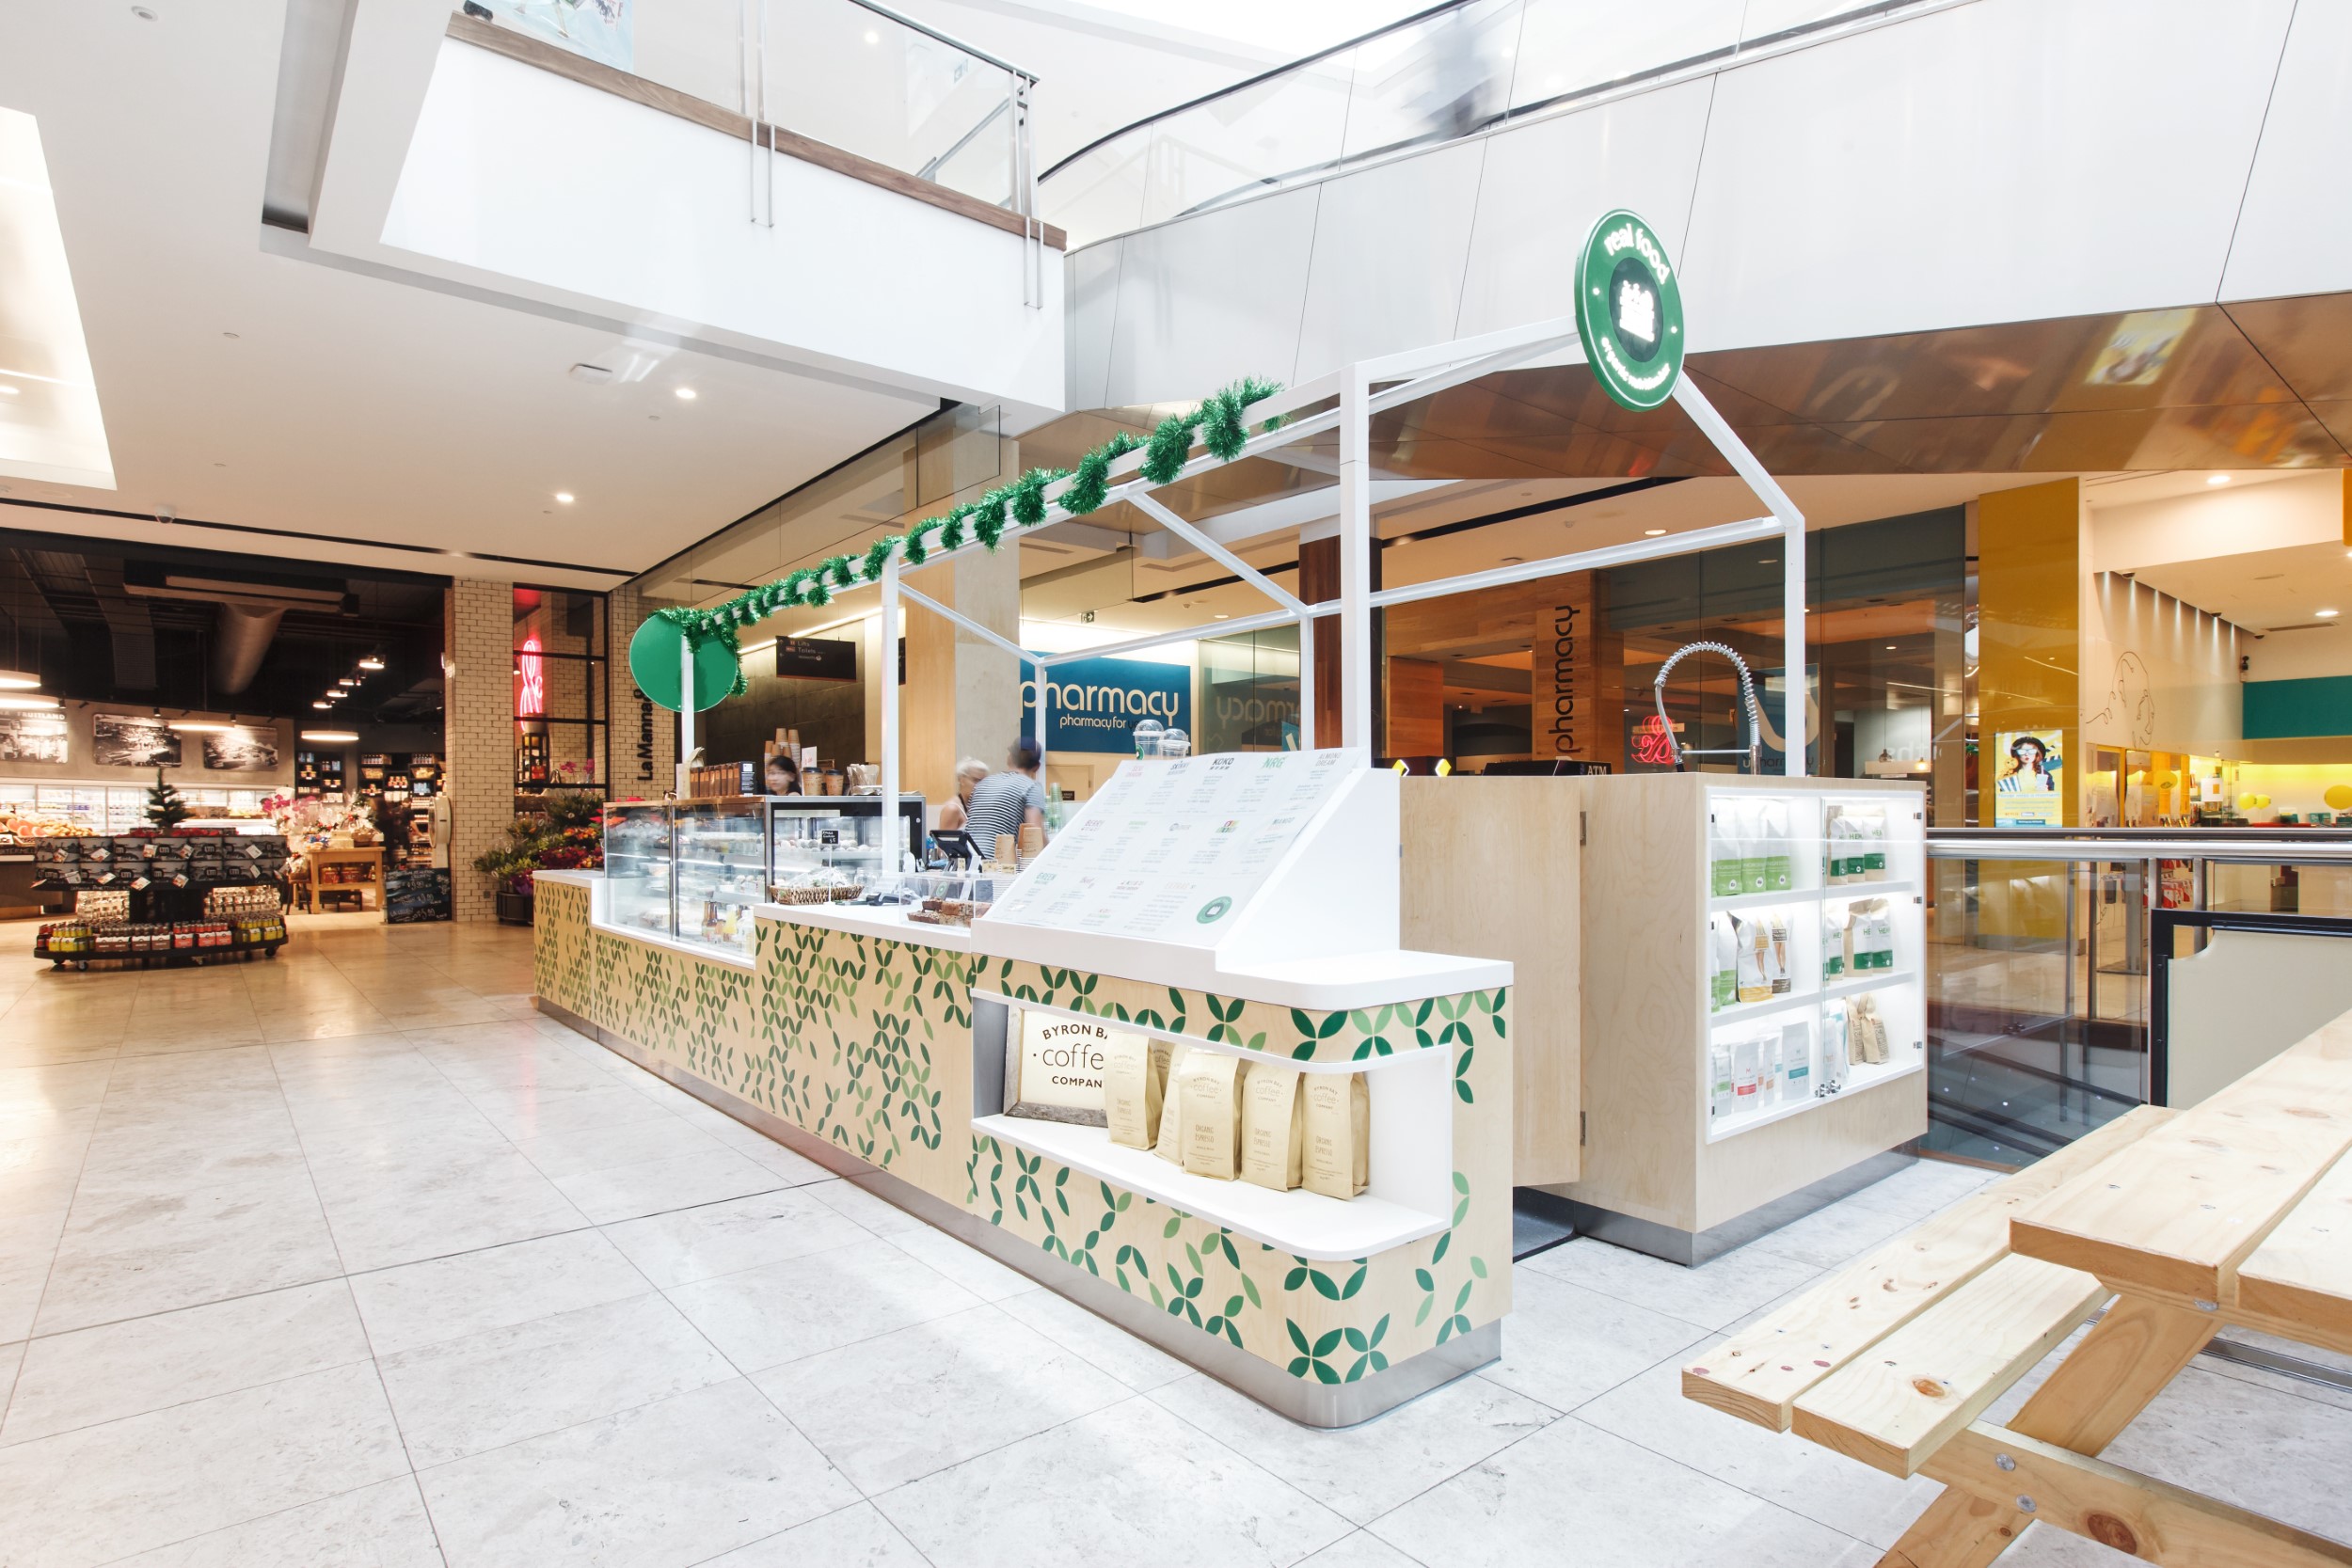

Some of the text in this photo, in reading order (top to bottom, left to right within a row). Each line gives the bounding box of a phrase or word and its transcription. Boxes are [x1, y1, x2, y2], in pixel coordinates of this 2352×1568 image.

[1604, 223, 1670, 284] real food
[1549, 605, 1581, 752] pharmacy
[1020, 672, 1178, 726] pharmacy
[1059, 713, 1111, 731] pharmacy
[1112, 716, 1127, 728] for
[637, 703, 653, 760] Manna
[1262, 756, 1285, 768] NRG
[1587, 765, 1607, 775] ATM
[637, 762, 653, 781] La
[1042, 1024, 1091, 1040] BYRON
[1052, 1076, 1103, 1088] COMPAN
[1193, 1084, 1218, 1094] coffee
